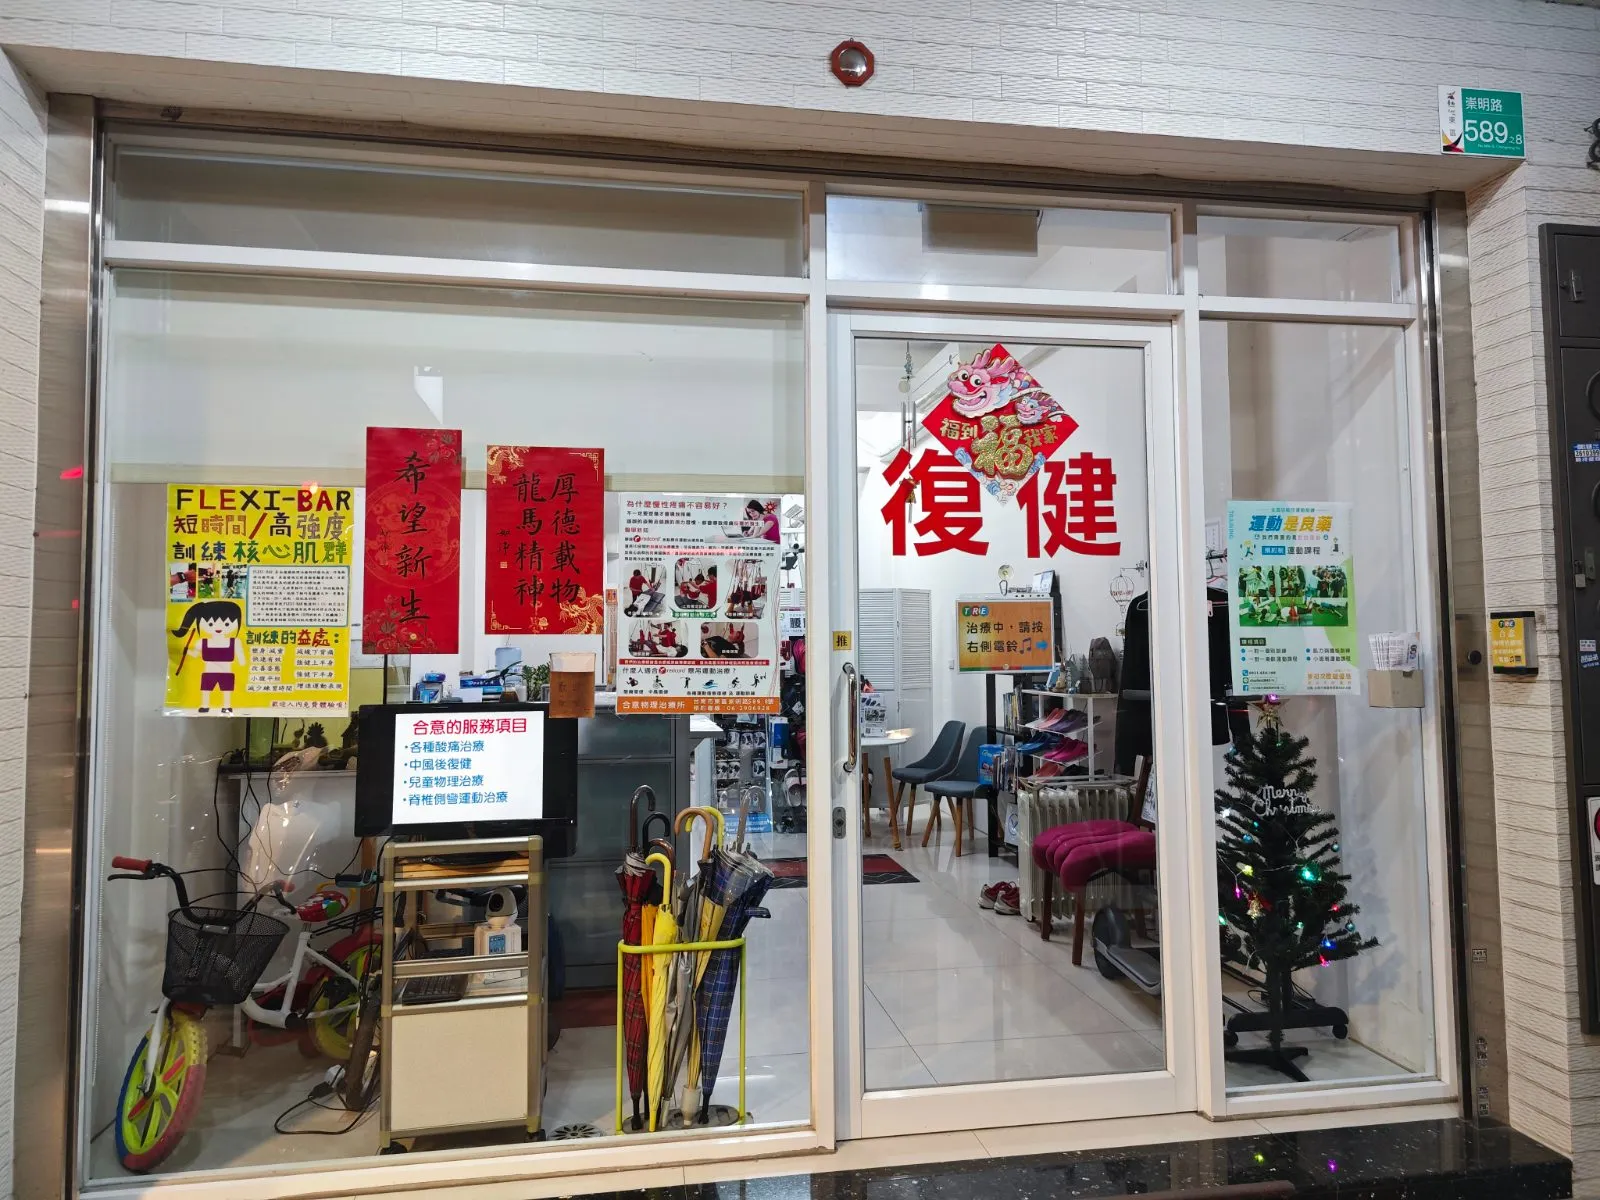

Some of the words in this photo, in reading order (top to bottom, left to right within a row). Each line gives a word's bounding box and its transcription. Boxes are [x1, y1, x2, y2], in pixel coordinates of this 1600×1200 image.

[1466, 97, 1502, 112] 崇明路
[940, 417, 977, 441] 福到
[176, 489, 351, 512] FLEXI-BAR
[881, 447, 1121, 559] 復健
[1248, 515, 1333, 532] 運動是良藥
[393, 450, 432, 624] 希望新生
[513, 473, 547, 609] 龍馬精神
[550, 473, 581, 604] 厚德載物
[172, 540, 348, 564] 訓練核心肌群
[963, 606, 988, 616] TRE
[836, 634, 848, 647] 推
[967, 640, 1018, 654] 右側電鈴
[413, 717, 527, 736] 合意的服務項目
[410, 740, 485, 753] 各種酸痛治療
[409, 758, 472, 771] 中風後復健
[409, 774, 484, 788] 兒童物理治療
[408, 791, 508, 807] 脊椎側彎運動治療
